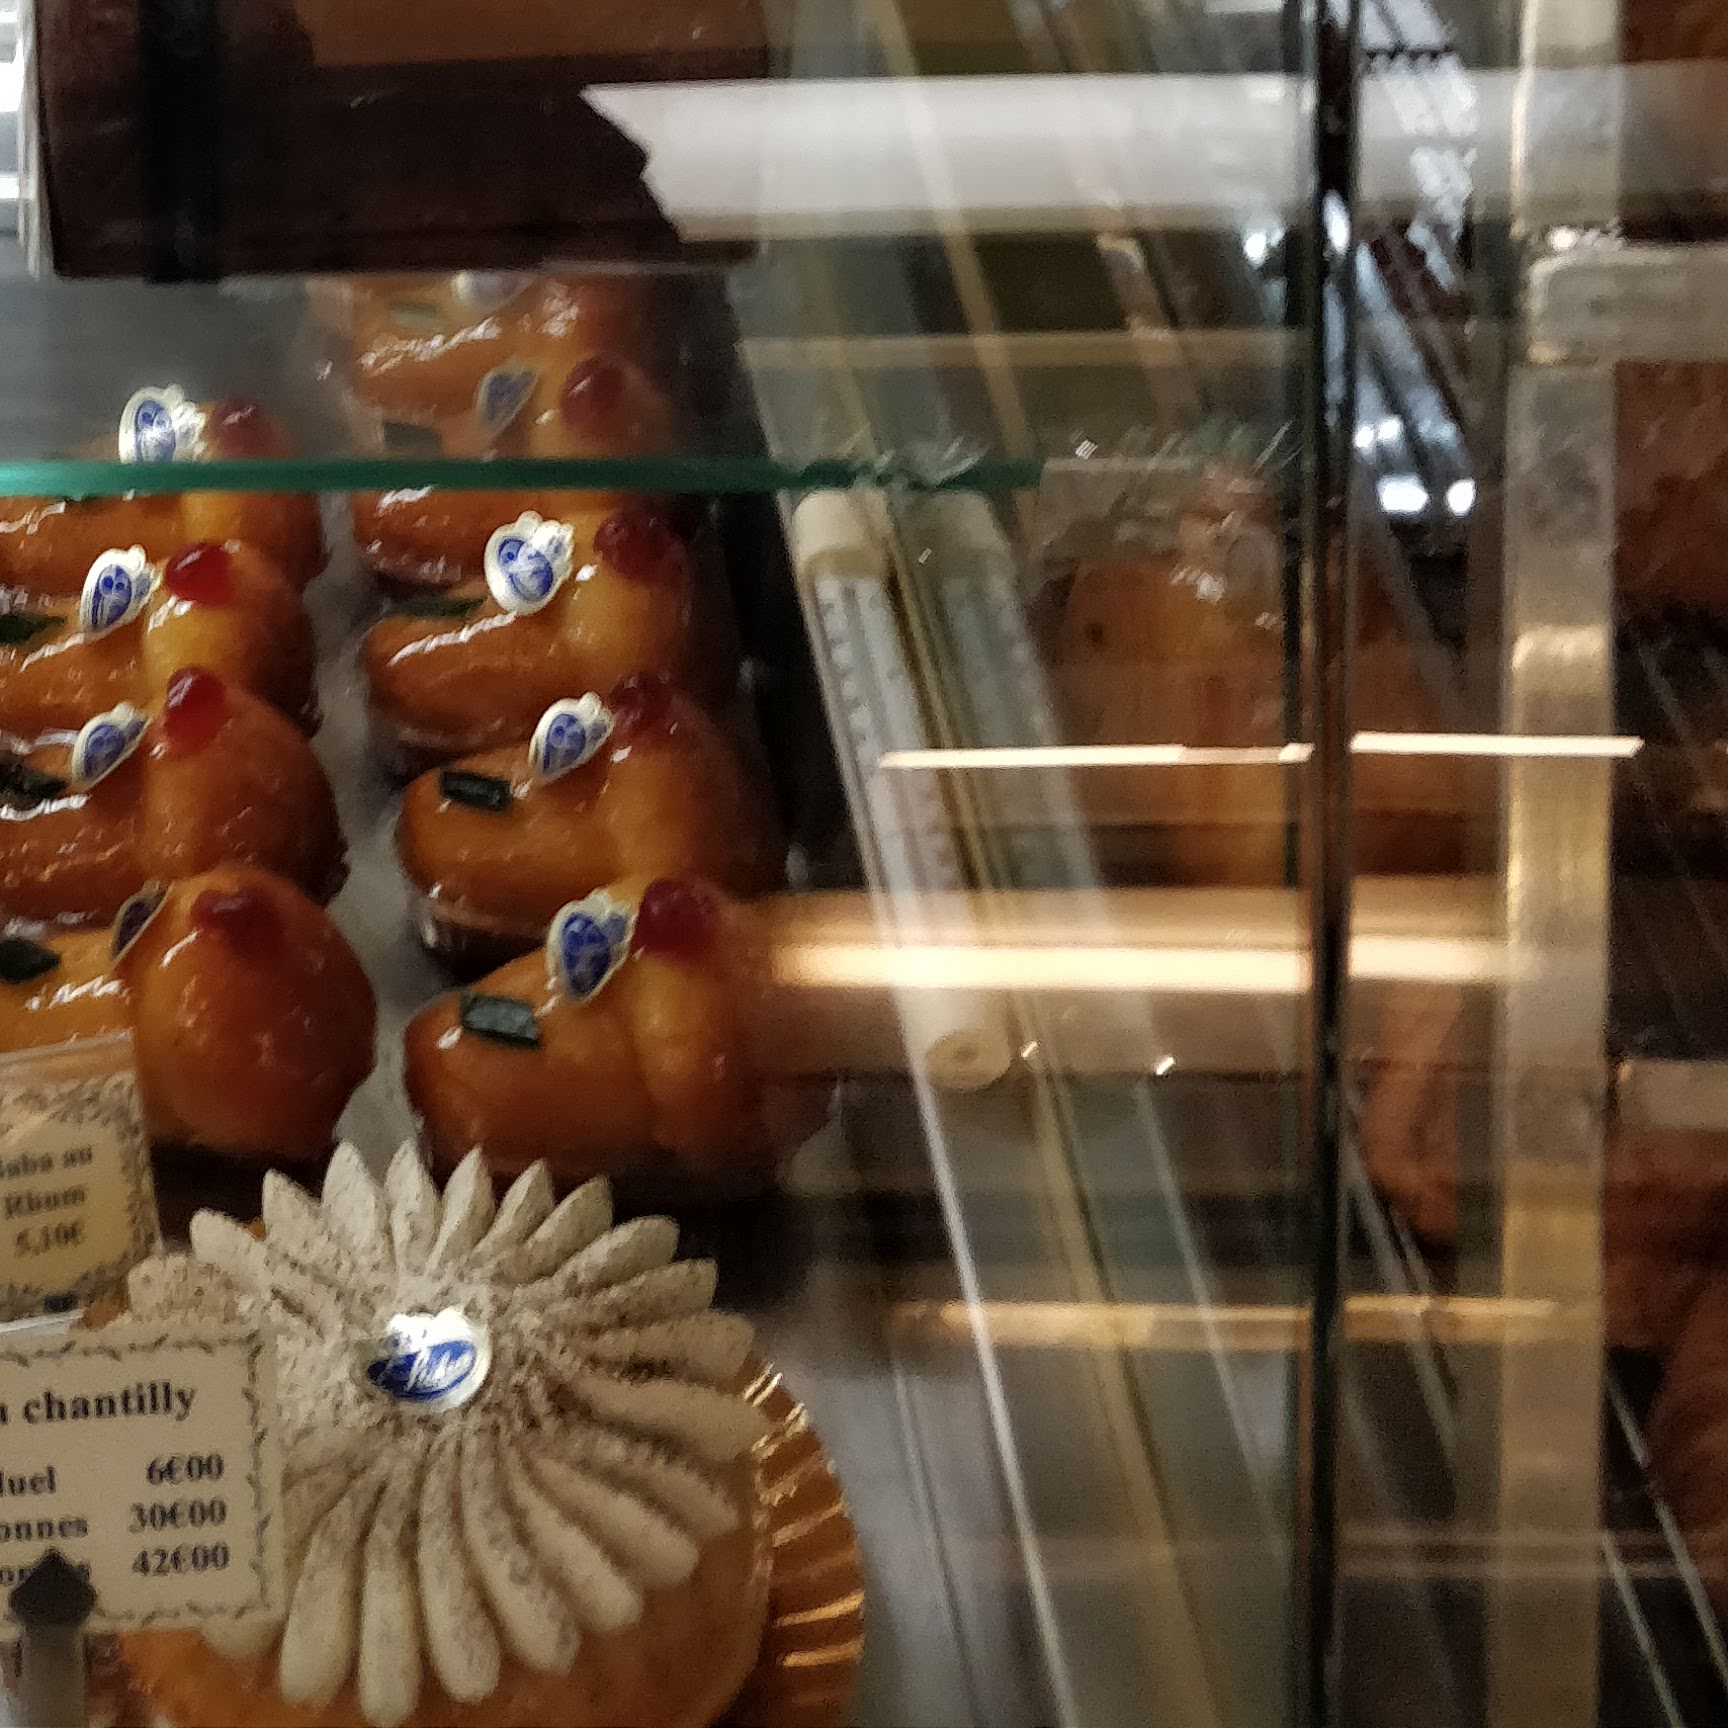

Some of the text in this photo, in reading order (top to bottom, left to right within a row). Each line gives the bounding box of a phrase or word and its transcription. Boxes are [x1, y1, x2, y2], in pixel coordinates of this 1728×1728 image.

[63, 1145, 93, 1168] au
[23, 1381, 196, 1423] chantilly
[146, 1454, 224, 1485] 6€00
[129, 1497, 227, 1534] 30€00
[133, 1544, 230, 1576] 42€00
